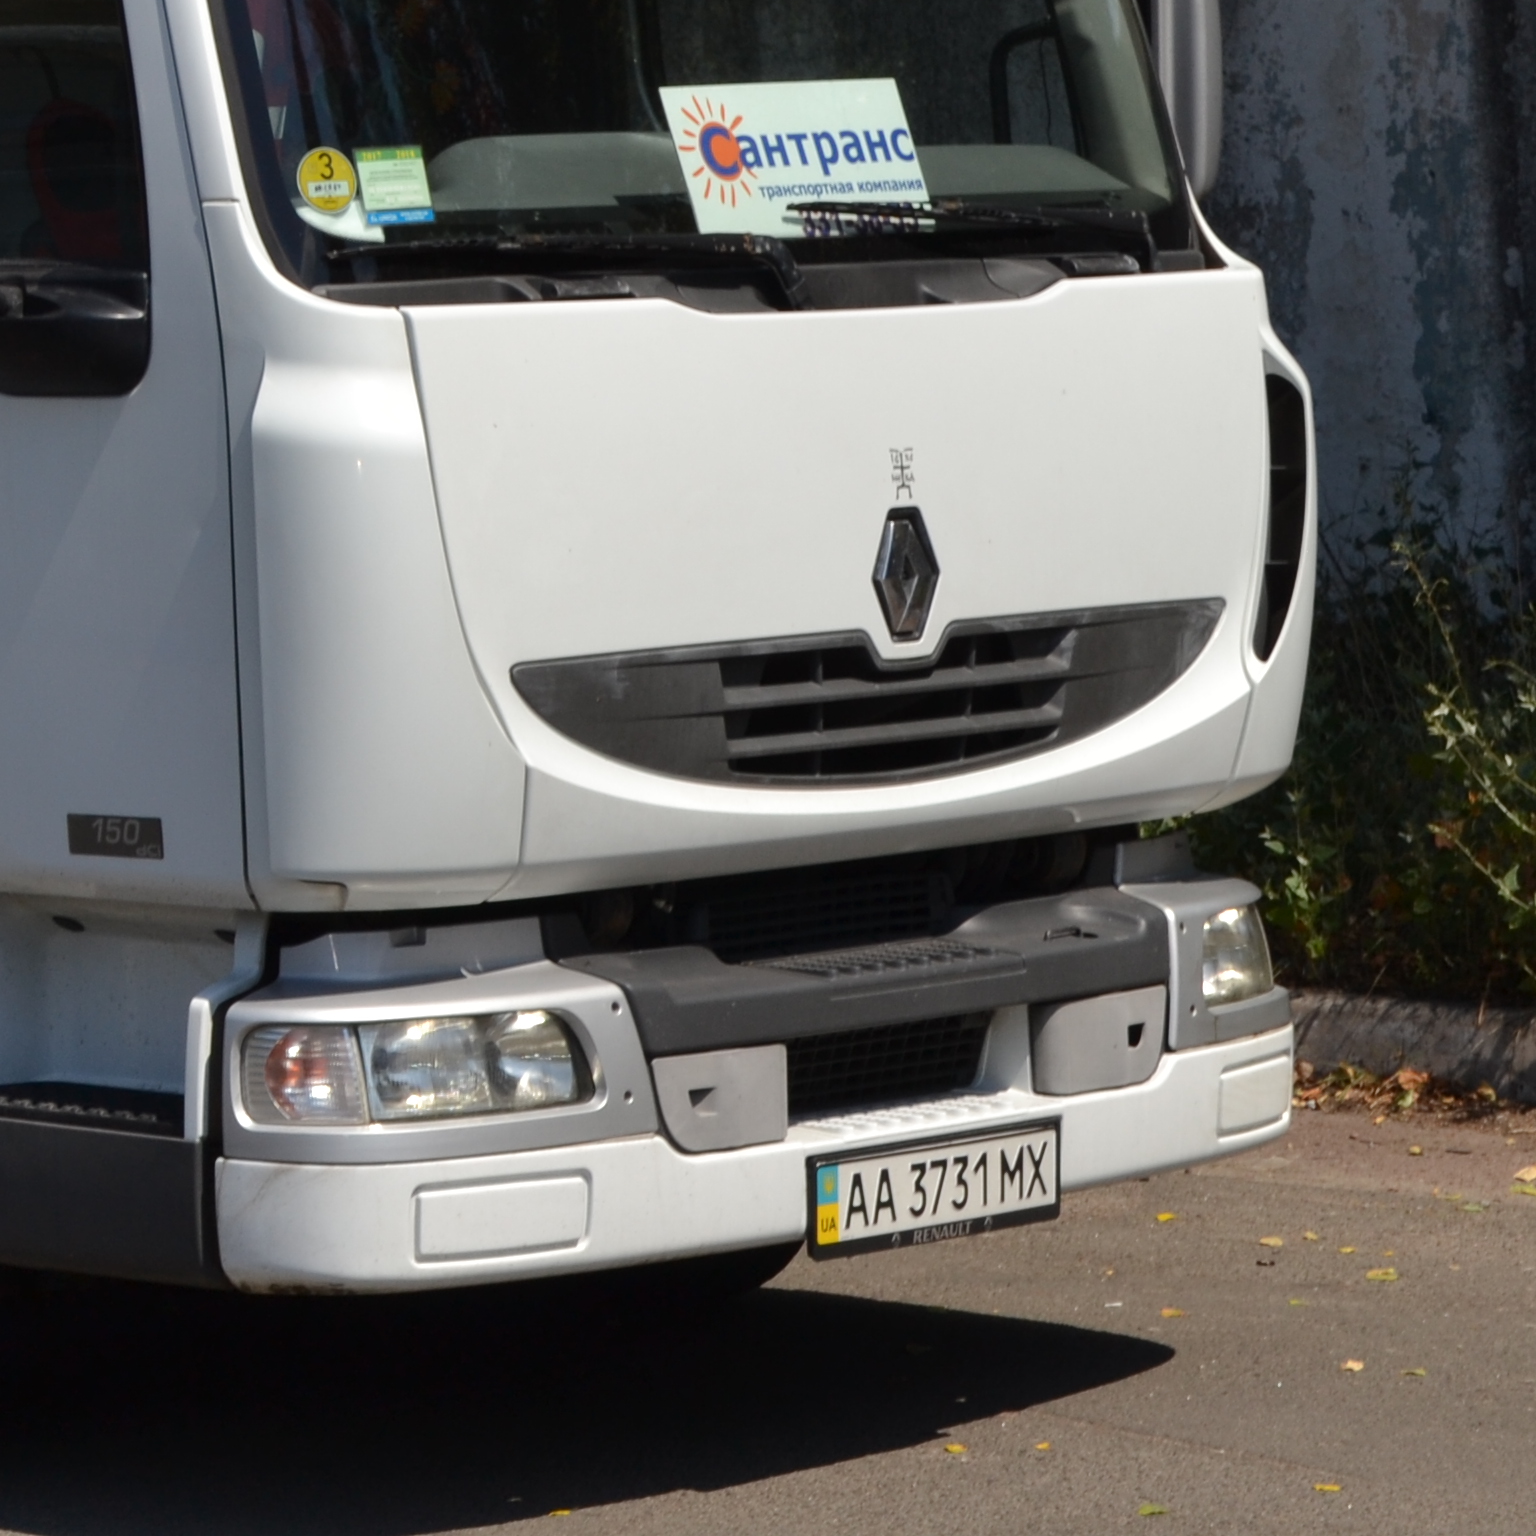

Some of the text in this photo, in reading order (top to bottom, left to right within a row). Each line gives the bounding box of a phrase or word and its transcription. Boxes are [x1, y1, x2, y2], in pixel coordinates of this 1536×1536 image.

[699, 124, 916, 177] Сантранс
[318, 152, 335, 181] 3
[759, 178, 924, 202] транспортная компания
[92, 817, 141, 845] 150
[843, 1140, 1048, 1230] AA 3731 MX
[820, 1215, 838, 1233] UA
[912, 1220, 974, 1245] RENAULT
